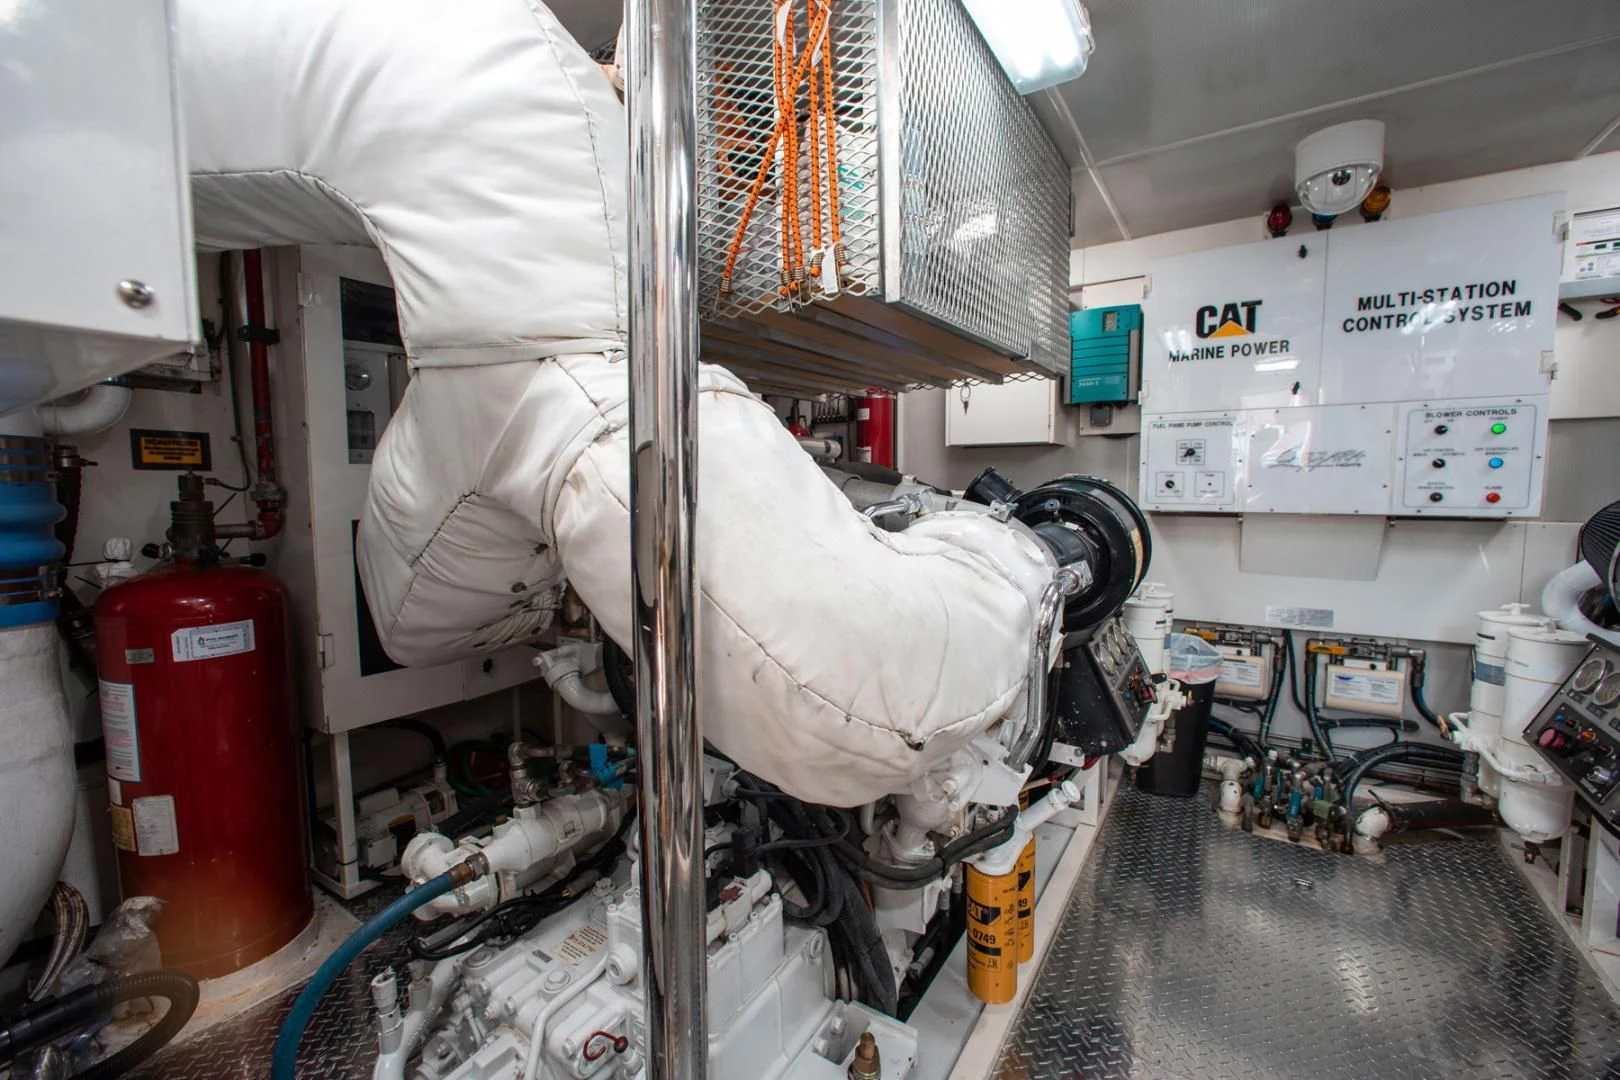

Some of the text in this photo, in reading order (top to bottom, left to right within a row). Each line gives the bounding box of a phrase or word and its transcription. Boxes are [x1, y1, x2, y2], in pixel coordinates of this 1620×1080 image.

[1358, 280, 1516, 311] MULTI-STATION
[1196, 300, 1263, 338] CAT
[1169, 339, 1290, 362] MARINE POWER
[1466, 408, 1517, 416] CONTROLS
